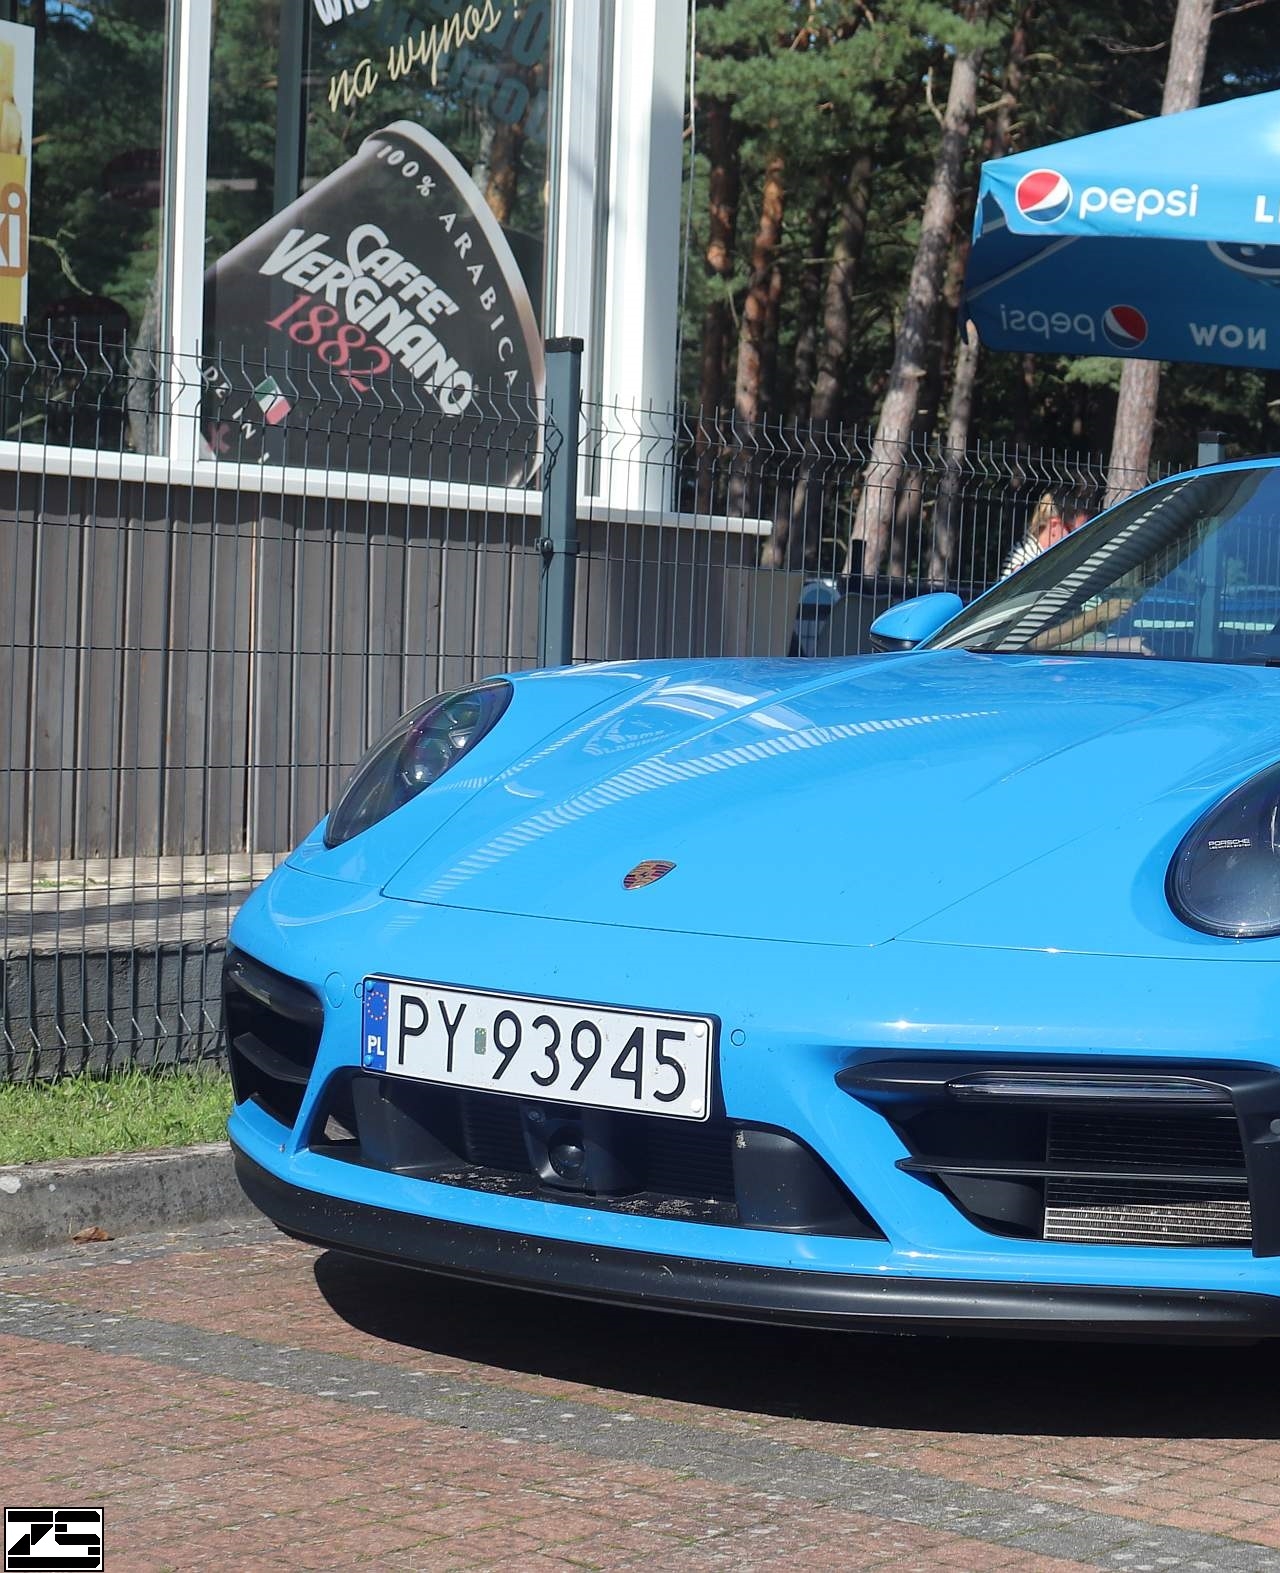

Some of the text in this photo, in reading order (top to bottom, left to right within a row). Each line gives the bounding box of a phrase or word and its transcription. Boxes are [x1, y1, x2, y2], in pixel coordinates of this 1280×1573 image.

[328, 58, 378, 112] na
[1079, 184, 1199, 221] pepsi
[377, 145, 436, 197] 100%
[439, 213, 518, 388] ARABICA
[258, 228, 474, 416] VERGNANO
[265, 295, 391, 392] 1882
[367, 1034, 385, 1056] PL
[398, 995, 686, 1102] PY 93945
